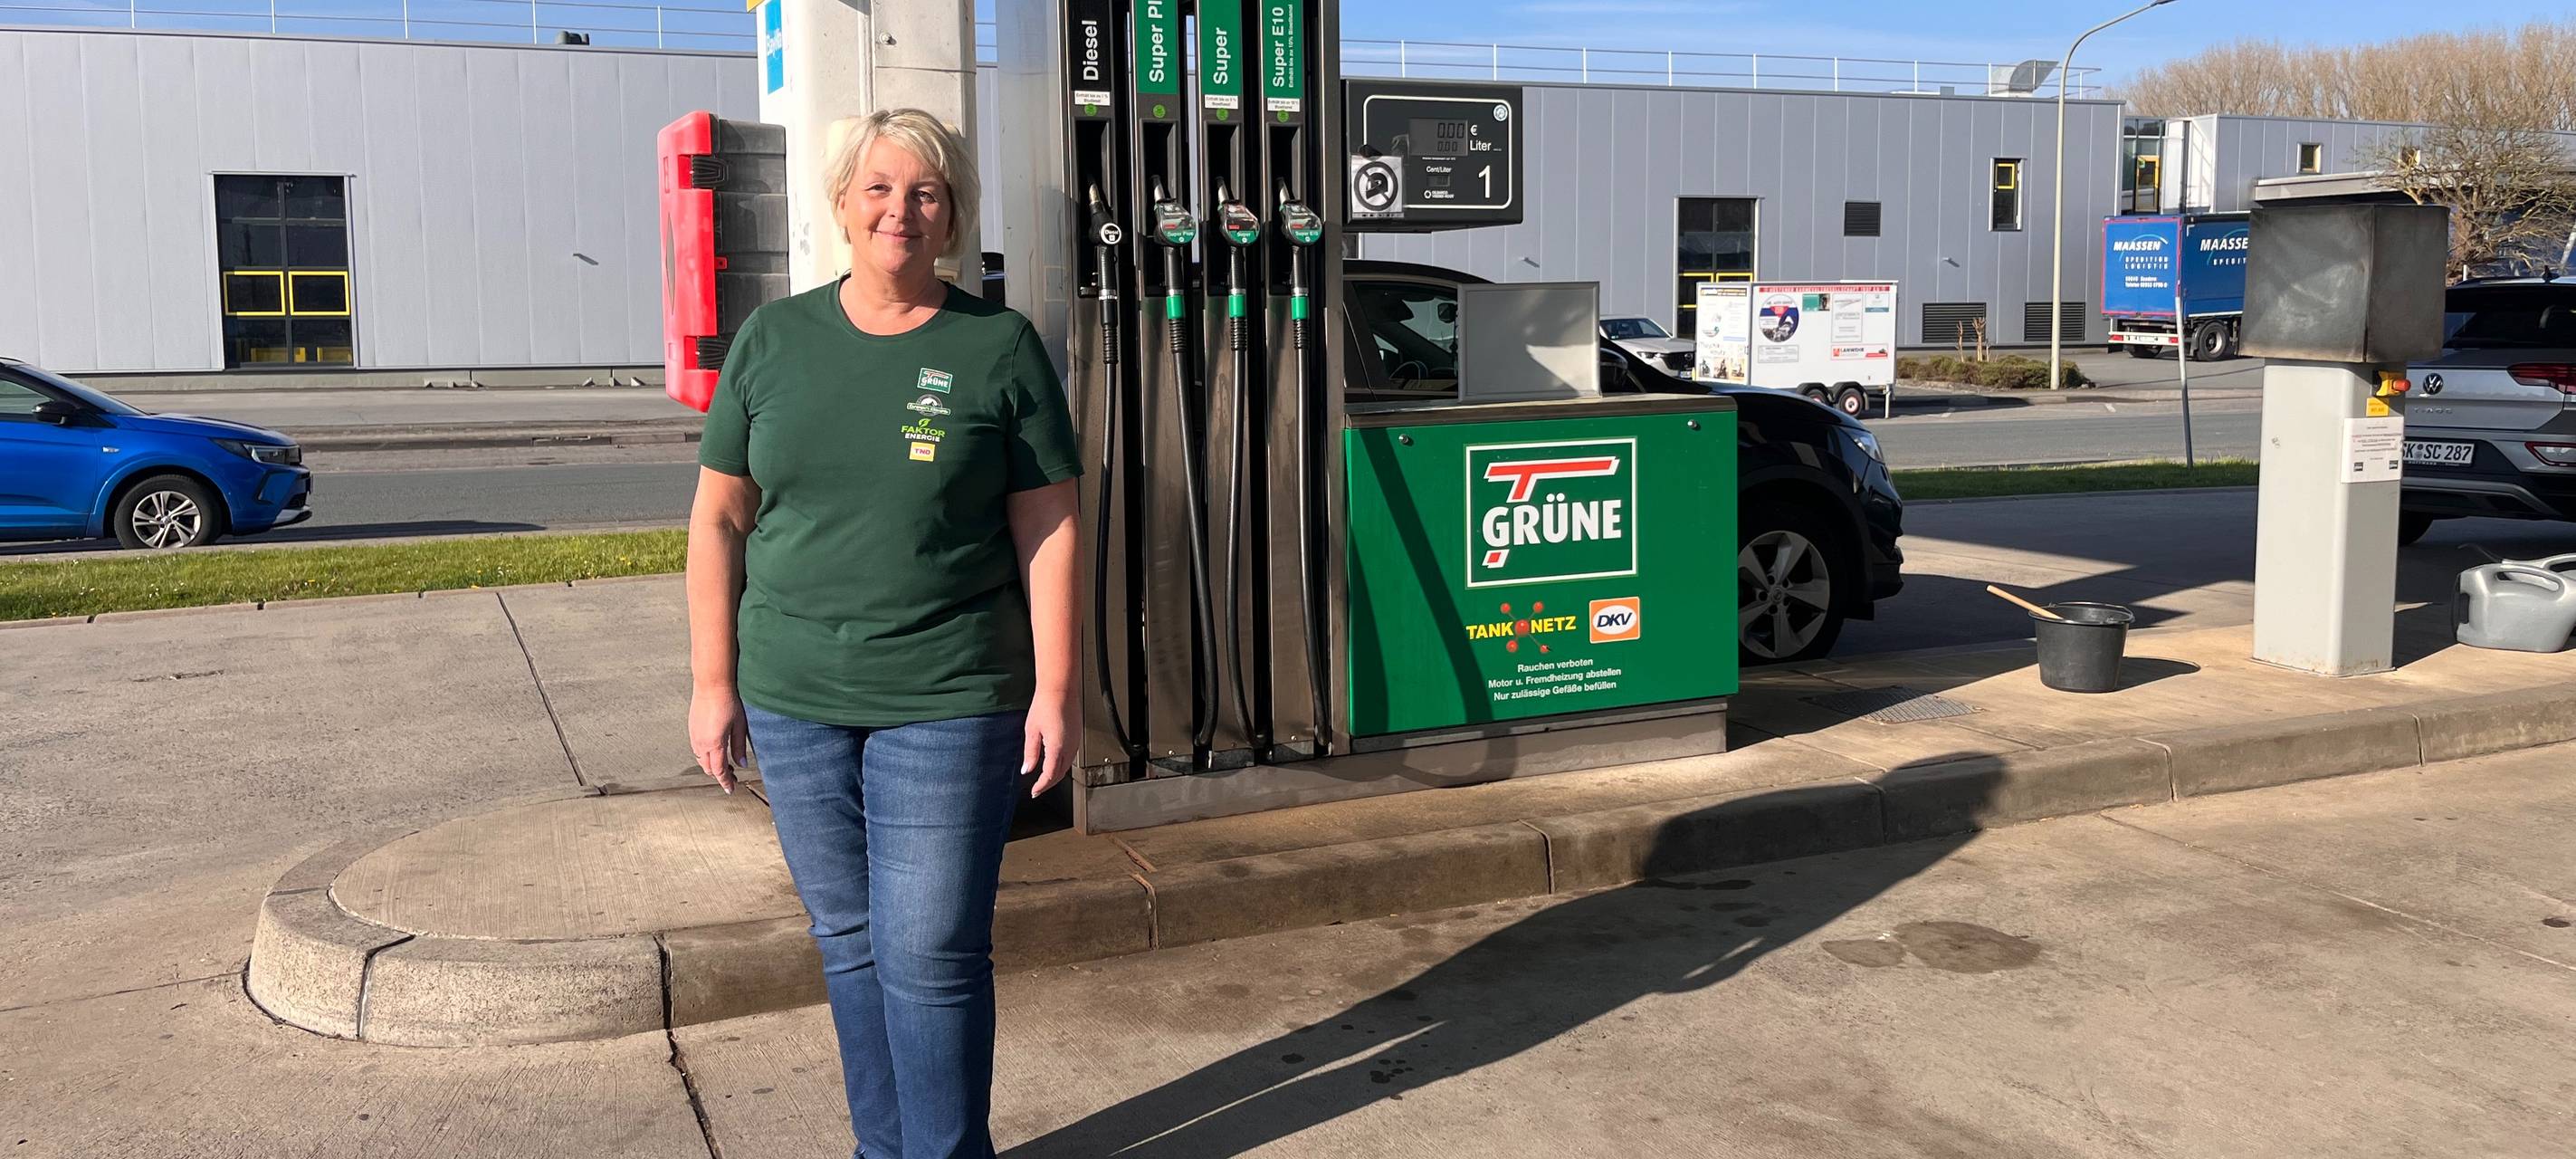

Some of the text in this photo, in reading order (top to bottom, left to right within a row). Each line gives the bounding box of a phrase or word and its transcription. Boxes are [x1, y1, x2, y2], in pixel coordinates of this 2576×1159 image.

[1082, 20, 1099, 81] Diesel
[1150, 24, 1168, 83] Super
[1214, 27, 1231, 85] Super
[1273, 7, 1287, 88] Super E10
[1470, 140, 1492, 151] Liter
[1426, 166, 1452, 174] Cent/Liter
[1478, 165, 1491, 198] 1
[2113, 241, 2161, 252] MAASSEN
[2200, 237, 2248, 252] MAASSE
[921, 377, 949, 388] GRÜNE
[902, 426, 945, 437] FAKTOR
[905, 433, 940, 442] ENERGIE
[2424, 444, 2442, 459] SC
[2444, 445, 2472, 461] 287
[1482, 493, 1622, 548] GRÜNE
[1466, 616, 1577, 639] TANK NETZ
[1597, 612, 1633, 628] DKV
[1518, 657, 1593, 673] Rauchen verboten
[1488, 677, 1512, 688] Motor
[1526, 672, 1583, 687] Fremdheizung
[1586, 667, 1621, 679] abstellen
[1493, 680, 1617, 701] Nur zulässige Gefäße befüllen
